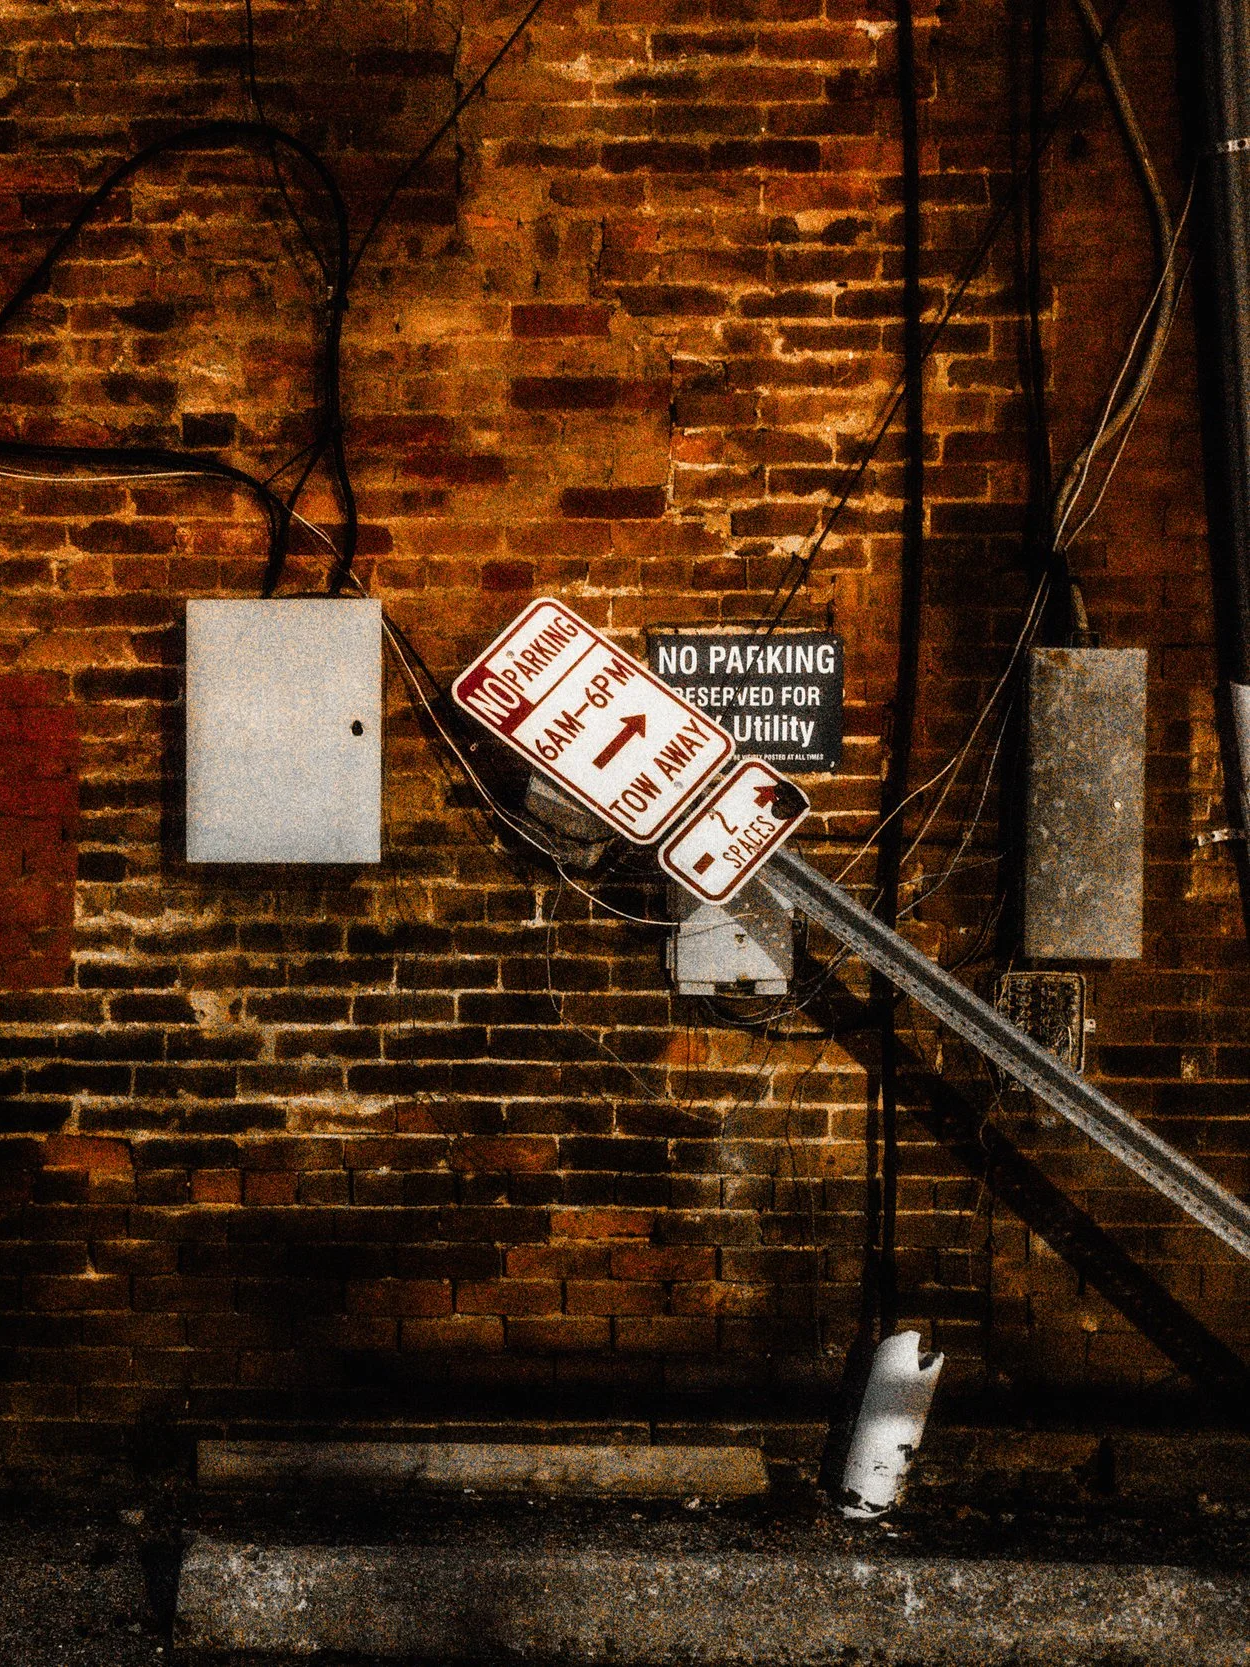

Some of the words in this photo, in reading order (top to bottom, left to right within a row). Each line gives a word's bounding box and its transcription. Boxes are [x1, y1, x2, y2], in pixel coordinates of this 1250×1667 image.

[466, 673, 520, 726] NO
[501, 615, 579, 692] PARKING
[658, 645, 698, 675] NO
[709, 644, 835, 675] PARKING
[781, 686, 821, 706] FOR
[733, 714, 815, 748] Utility
[608, 771, 659, 824] TOW
[652, 717, 711, 782] AWAY
[709, 810, 738, 836] 2
[722, 814, 777, 870] SPACES
